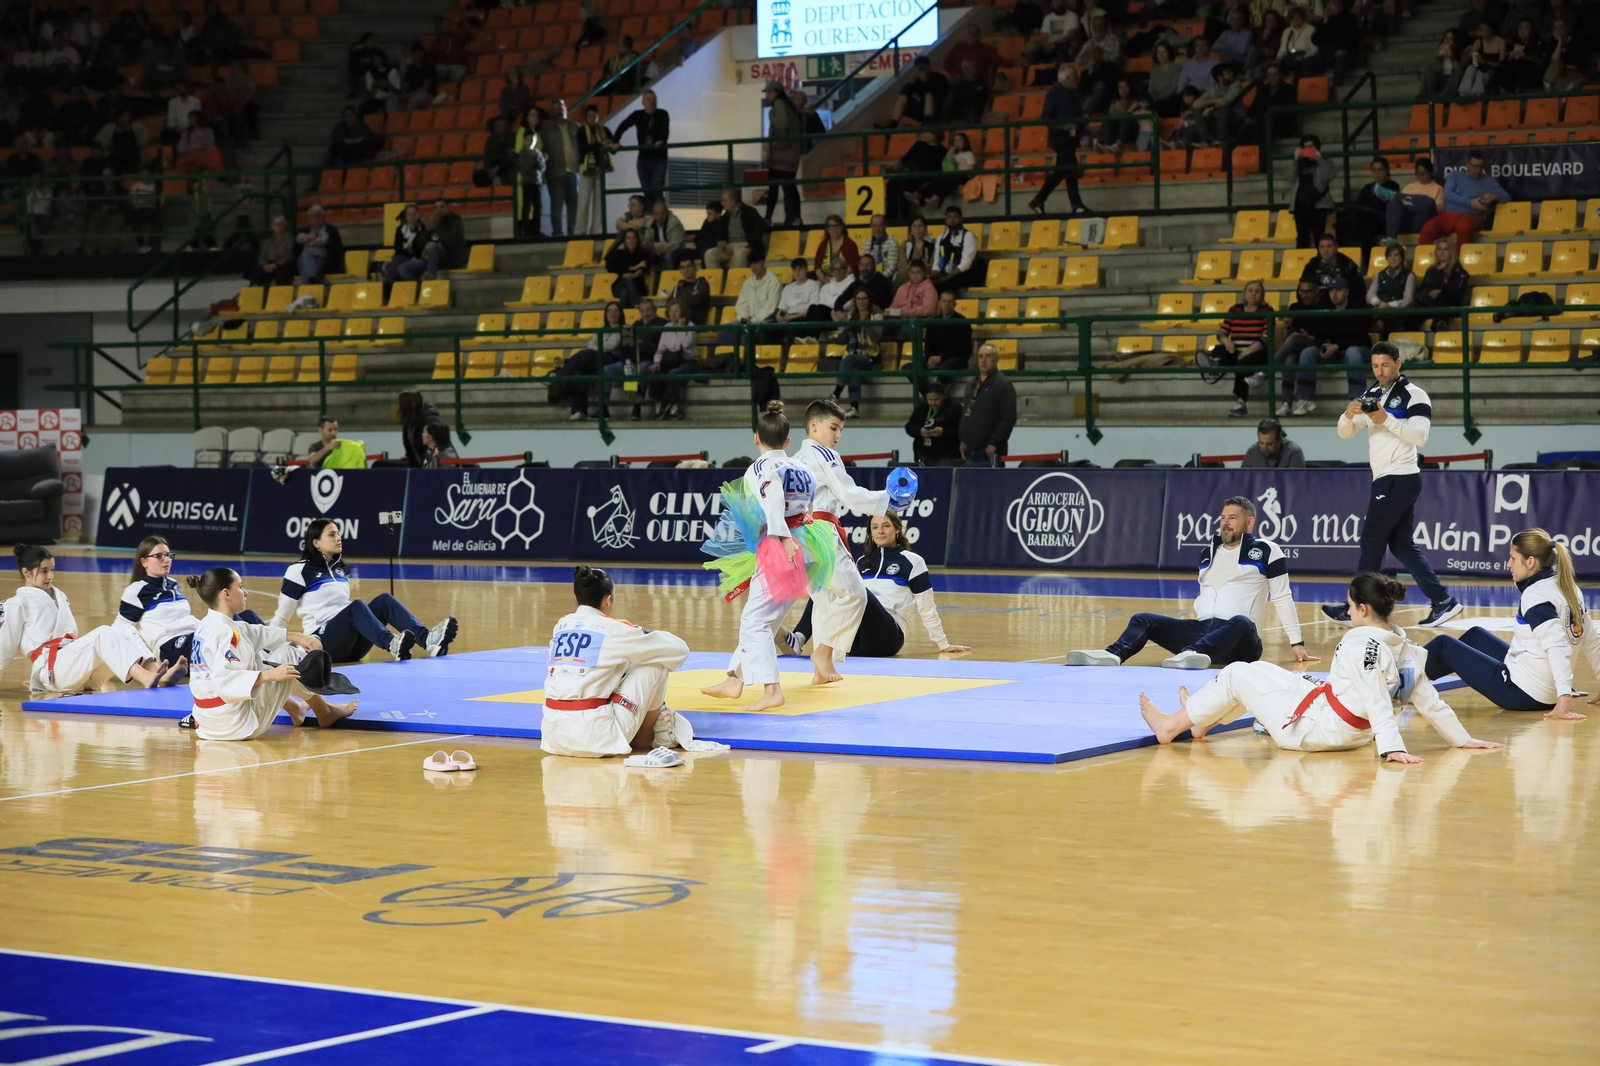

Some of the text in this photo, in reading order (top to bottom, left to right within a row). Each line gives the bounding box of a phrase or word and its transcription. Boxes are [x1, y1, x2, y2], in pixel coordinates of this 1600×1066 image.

[804, 24, 892, 47] OURENSE
[1491, 162, 1584, 177] BOULEVARD
[856, 185, 873, 216] 2
[463, 472, 470, 483] EL
[783, 468, 812, 493] ESP
[462, 483, 506, 495] COLMENAR DE
[1027, 491, 1085, 506] ARROCERÍA
[146, 500, 238, 521] XURISGAL
[434, 484, 497, 529] Sara
[1022, 504, 1085, 534] GIJÓN
[1311, 513, 1361, 543] ma
[432, 540, 496, 551] Mel de Galicia
[1027, 532, 1076, 547] BARBAÑA
[1413, 521, 1480, 551] Alán
[1447, 558, 1491, 571] Seguros
[1494, 561, 1500, 570] e
[555, 632, 592, 657] ESP
